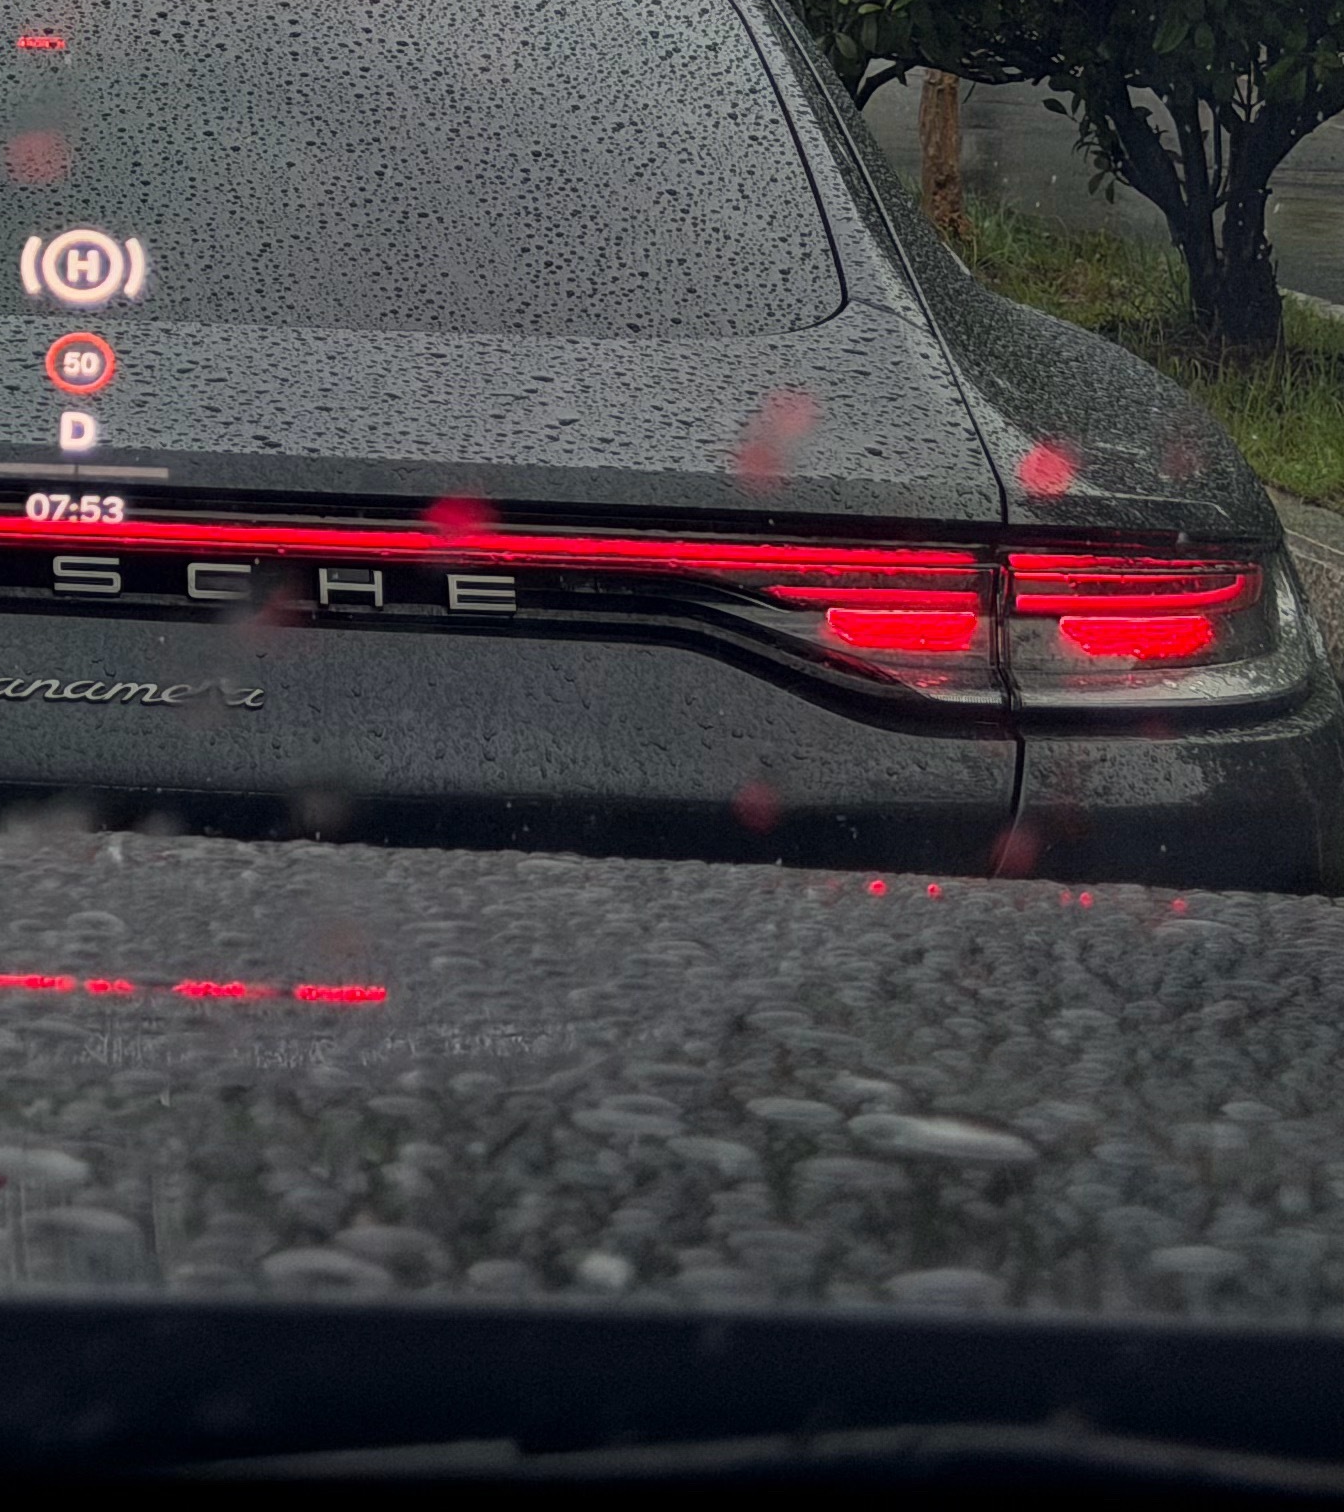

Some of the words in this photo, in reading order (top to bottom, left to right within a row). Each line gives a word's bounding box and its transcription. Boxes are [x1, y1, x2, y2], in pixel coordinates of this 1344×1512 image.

[63, 351, 100, 376] 50
[59, 411, 97, 452] D
[25, 492, 125, 524] 07:53
